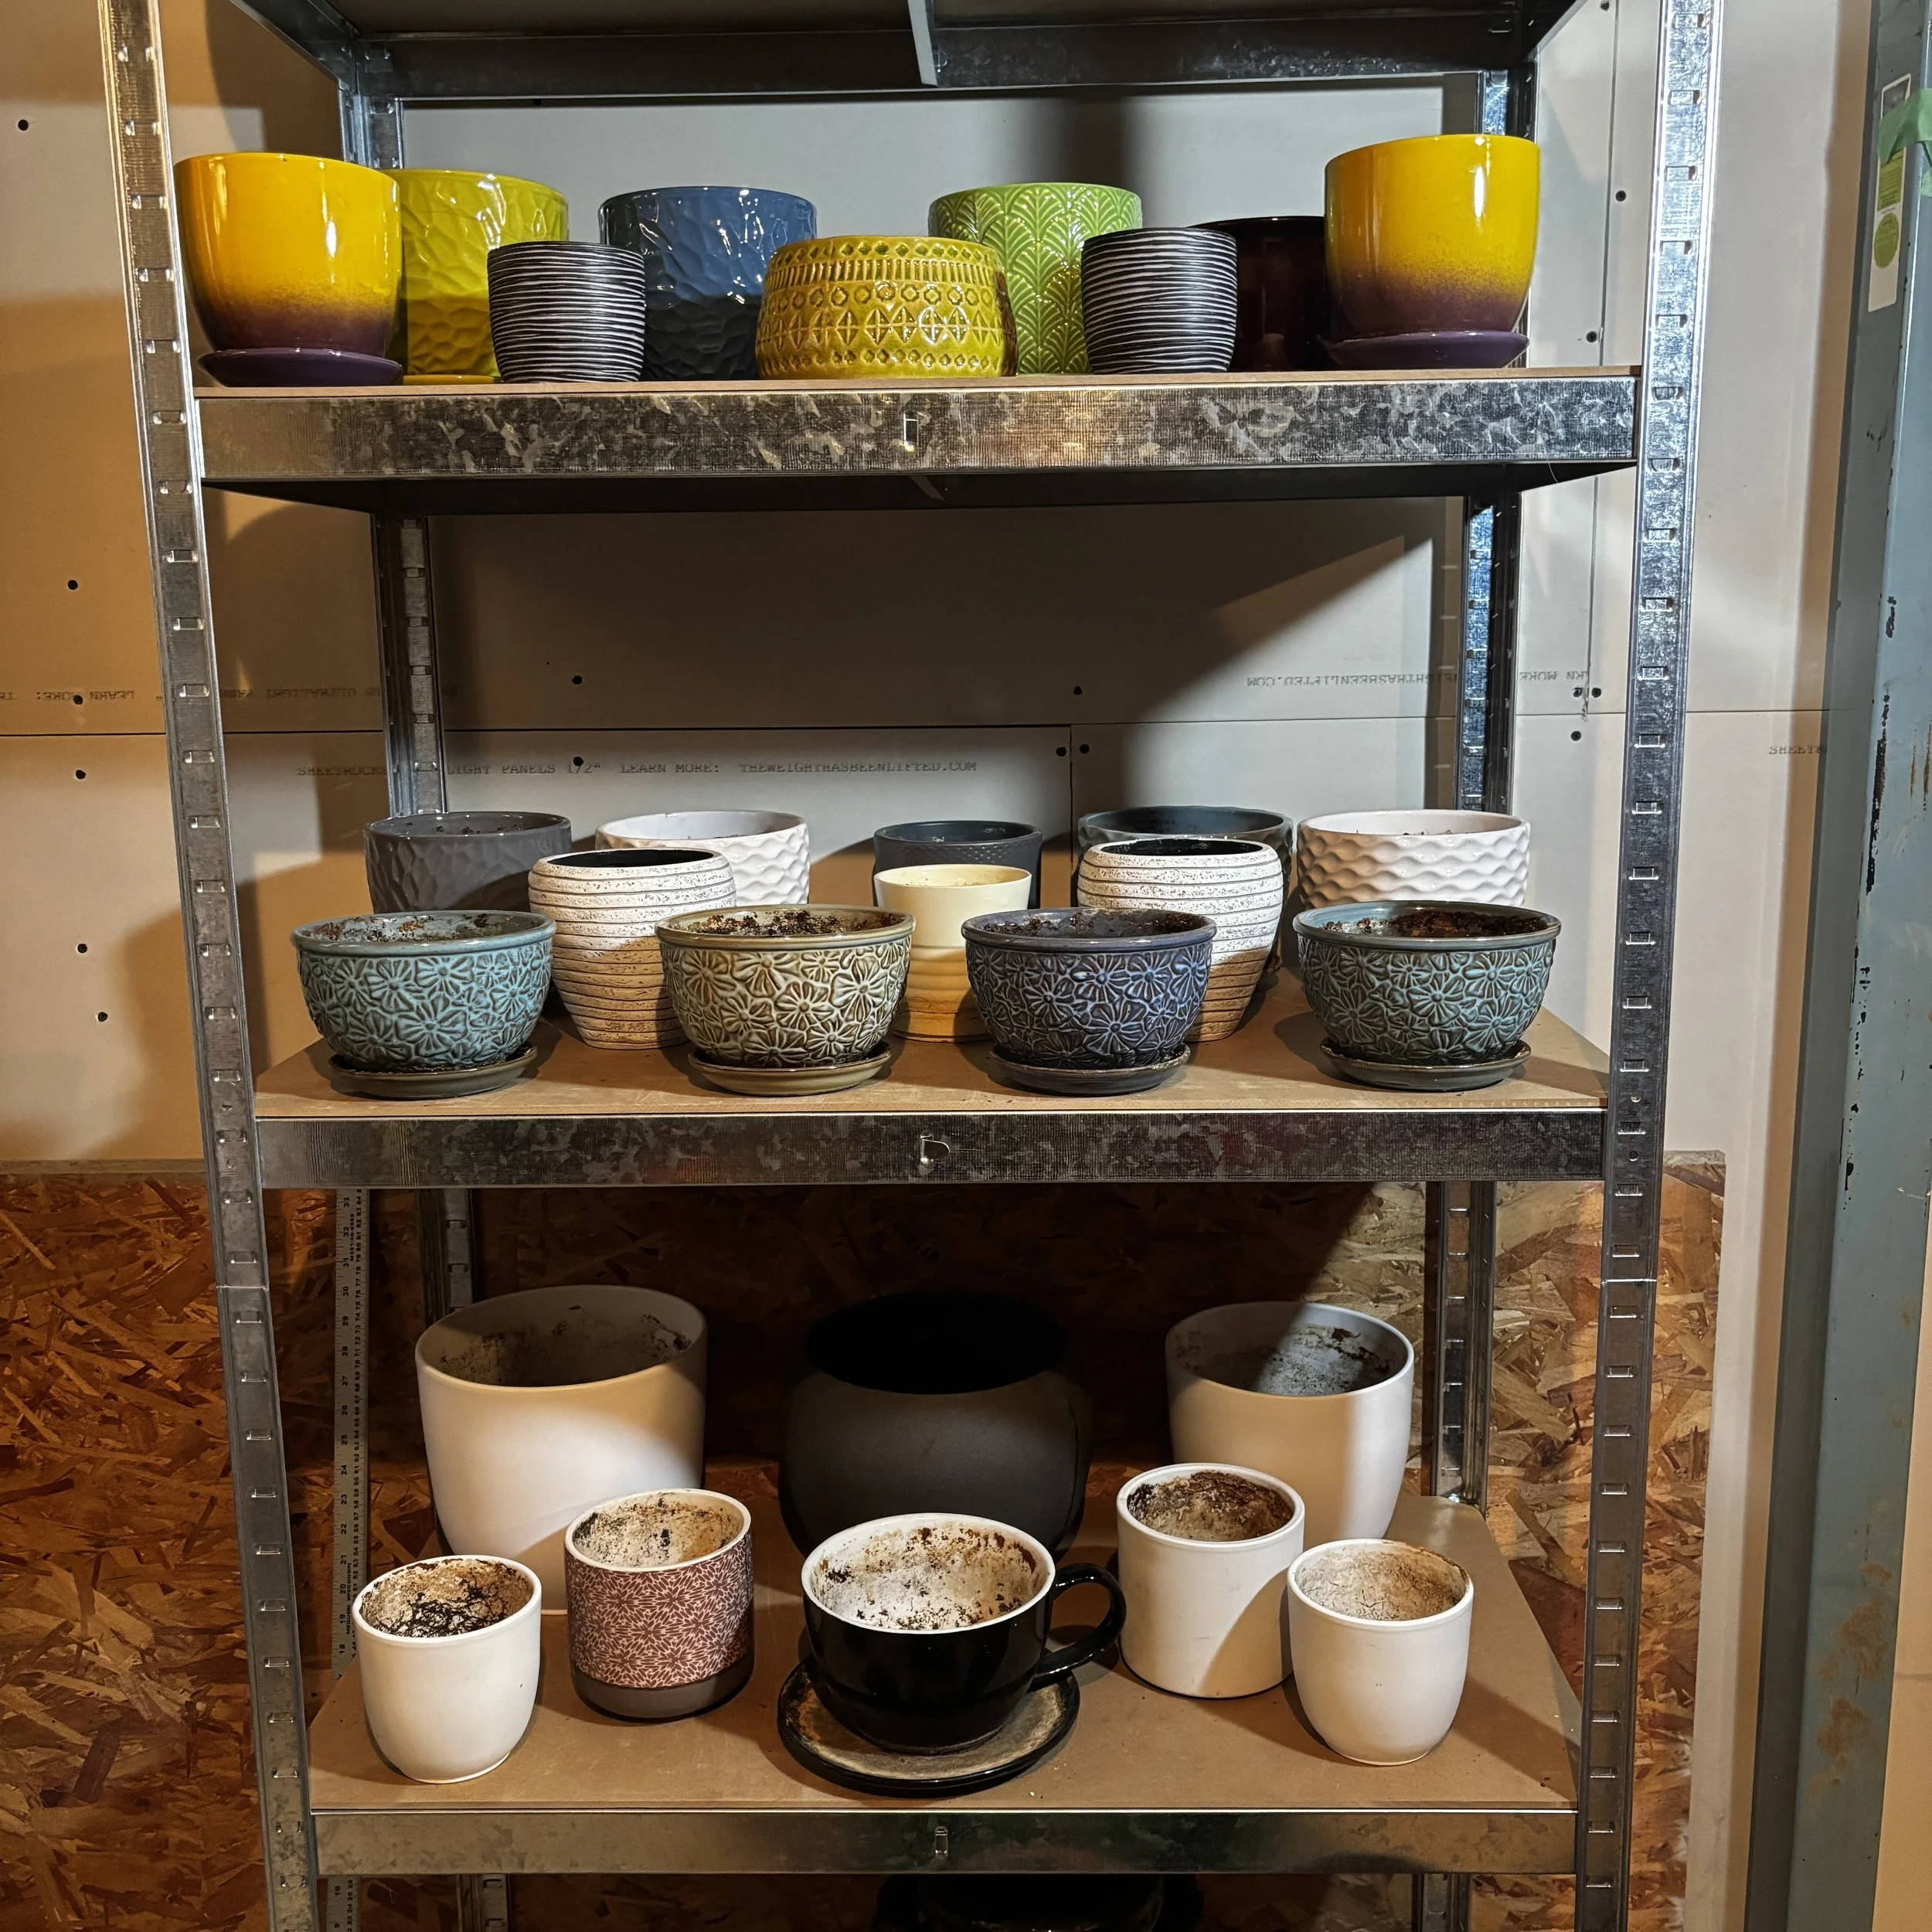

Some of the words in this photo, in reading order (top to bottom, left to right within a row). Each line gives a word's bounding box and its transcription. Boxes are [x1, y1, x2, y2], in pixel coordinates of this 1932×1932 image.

[1246, 673, 1458, 687] EIGHTHASBEENLIFTED.COM
[37, 692, 80, 701] ORE:
[90, 691, 134, 700] LEARN
[447, 765, 491, 774] LIGHT
[502, 765, 556, 774] PANELS
[620, 764, 667, 774] LEARN
[675, 764, 719, 773] MORE:
[739, 762, 977, 774] THEWEIGHTHASBEENLIFTED.COM
[343, 1198, 349, 1207] 33
[343, 1227, 349, 1236] 32
[343, 1258, 349, 1267] 31
[343, 1287, 349, 1296] 30
[342, 1316, 348, 1326] 29
[342, 1346, 348, 1356] 28
[342, 1376, 348, 1386] 27
[342, 1405, 347, 1415] 26
[342, 1435, 347, 1444] 25
[341, 1465, 347, 1475] 24
[341, 1495, 347, 1505] 23
[341, 1524, 346, 1534] 22
[341, 1555, 346, 1565] 21
[340, 1584, 345, 1594] 20
[340, 1614, 345, 1624] 19
[339, 1645, 345, 1654] 18
[335, 1886, 340, 1896] 10
